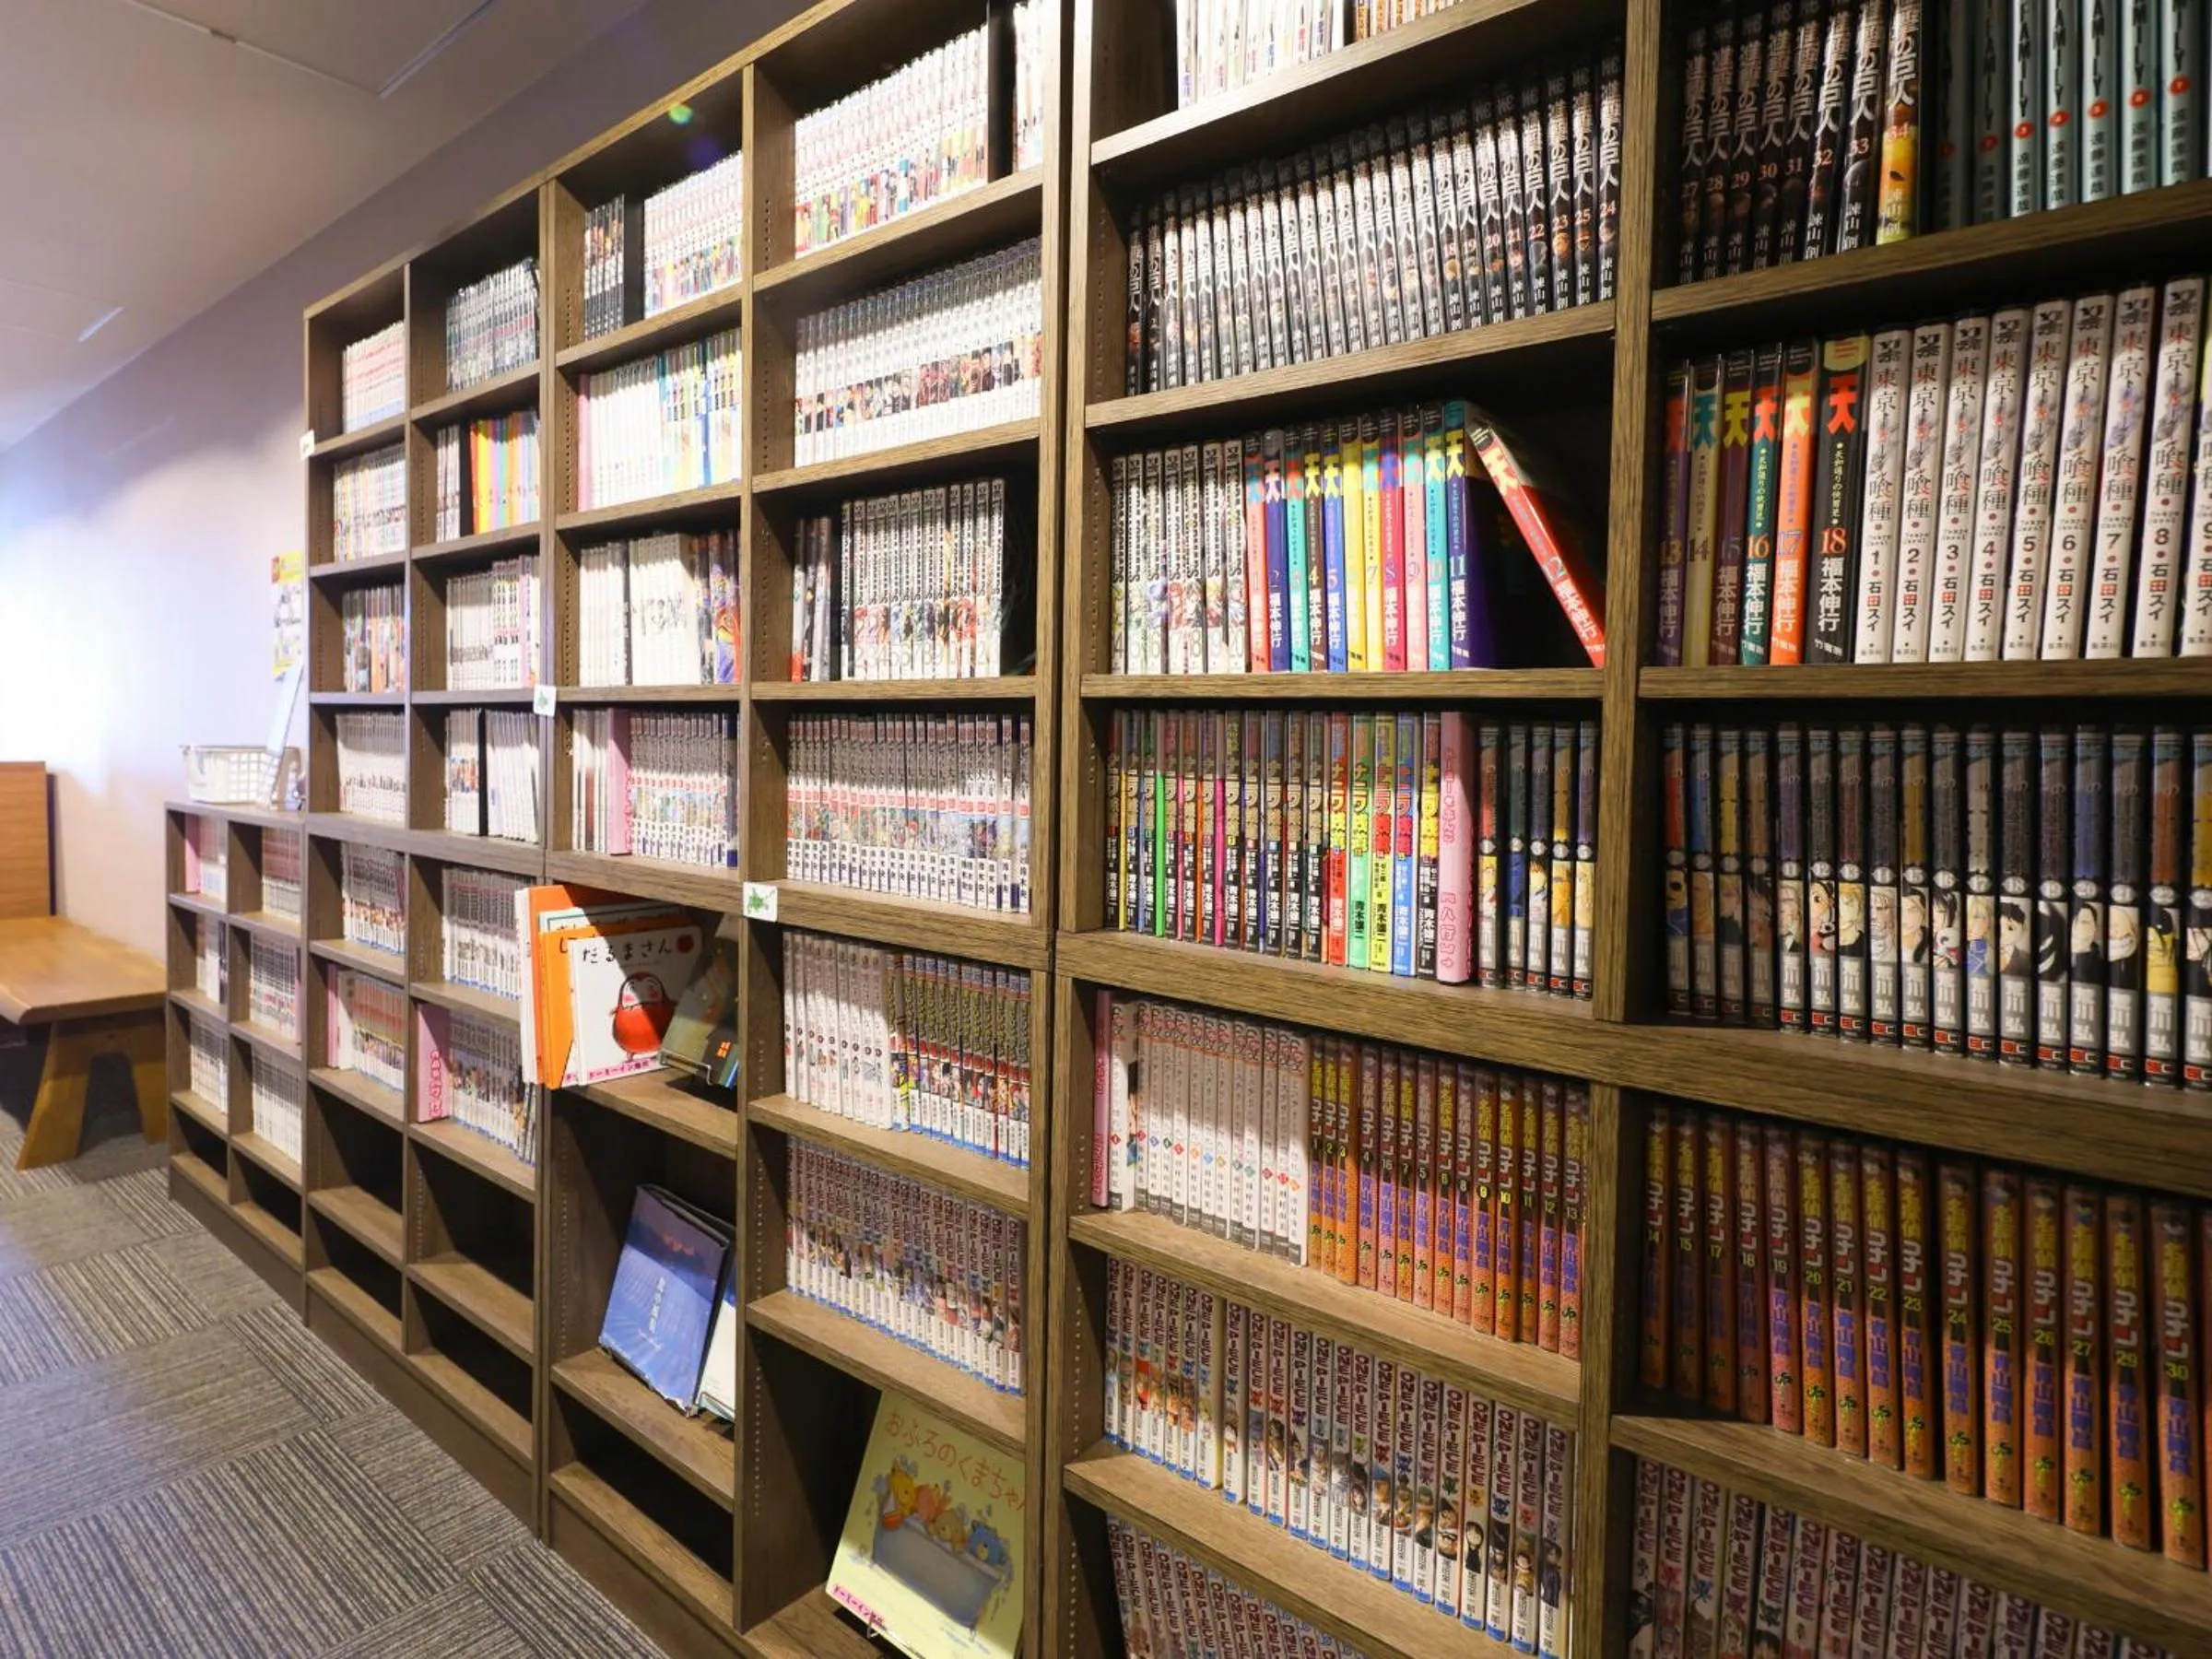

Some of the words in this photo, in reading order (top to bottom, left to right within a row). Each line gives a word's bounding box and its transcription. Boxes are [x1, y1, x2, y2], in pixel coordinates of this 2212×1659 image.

[1889, 124, 1909, 140] 34
[1849, 138, 1869, 155] 33
[1785, 158, 1803, 175] 31
[1814, 149, 1833, 167] 32
[1731, 171, 1750, 188] 29
[1758, 162, 1777, 180] 30
[1708, 175, 1723, 192] 28
[1574, 209, 1591, 226] 25
[1600, 200, 1617, 218] 24
[1553, 214, 1568, 230] 23
[1530, 224, 1545, 238] 22
[1828, 376, 1858, 434] 天
[1447, 429, 1465, 480] 天
[1305, 453, 1321, 498] 天
[1778, 530, 1803, 555] 17
[1820, 527, 1847, 554] 18
[2023, 536, 2036, 552] 5
[2062, 535, 2076, 550] 6
[2106, 534, 2122, 549] 7
[2155, 528, 2169, 545] 8
[1688, 538, 1709, 561] 14
[1747, 534, 1770, 559] 16
[1946, 545, 1959, 560] 3
[1983, 541, 1995, 556] 4
[1872, 550, 1879, 565] 1
[1907, 548, 1920, 563] 2
[1450, 555, 1465, 577] 11
[1309, 566, 1319, 585] 4
[1328, 570, 1337, 587] 5
[1745, 563, 1767, 635] 福本伸行
[1818, 558, 1843, 631] 福本伸行
[1977, 573, 1995, 627] 石田スイ
[2016, 570, 2035, 623] 石田スイ
[2055, 569, 2075, 623] 石田スイ
[2100, 568, 2119, 623] 石田スイ
[2148, 563, 2169, 620] 石田スイ
[1866, 582, 1881, 631] 石田スイ
[1901, 580, 1919, 632] 石田スイ
[1940, 577, 1958, 629] 石田スイ
[1313, 1139, 1318, 1150] 1
[1326, 1143, 1333, 1154] 2
[1340, 1145, 1346, 1157] 3
[1363, 1151, 1370, 1163] 4
[1382, 1159, 1393, 1171] 16
[1403, 1162, 1408, 1175] 7
[1418, 1167, 1426, 1180] 5
[1500, 1191, 1511, 1204] 10
[1545, 1201, 1556, 1214] 12
[1567, 1207, 1578, 1219] 13
[1680, 1238, 1692, 1251] 15
[1711, 1244, 1722, 1258] 17
[1742, 1254, 1755, 1266] 18
[1773, 1259, 1787, 1273] 19
[1806, 1273, 1822, 1286] 20
[1869, 1287, 1886, 1300] 22
[1903, 1297, 1923, 1310] 23
[1948, 1310, 1968, 1324] 24
[2036, 1329, 2055, 1345] 26
[2167, 1364, 2189, 1381] 30
